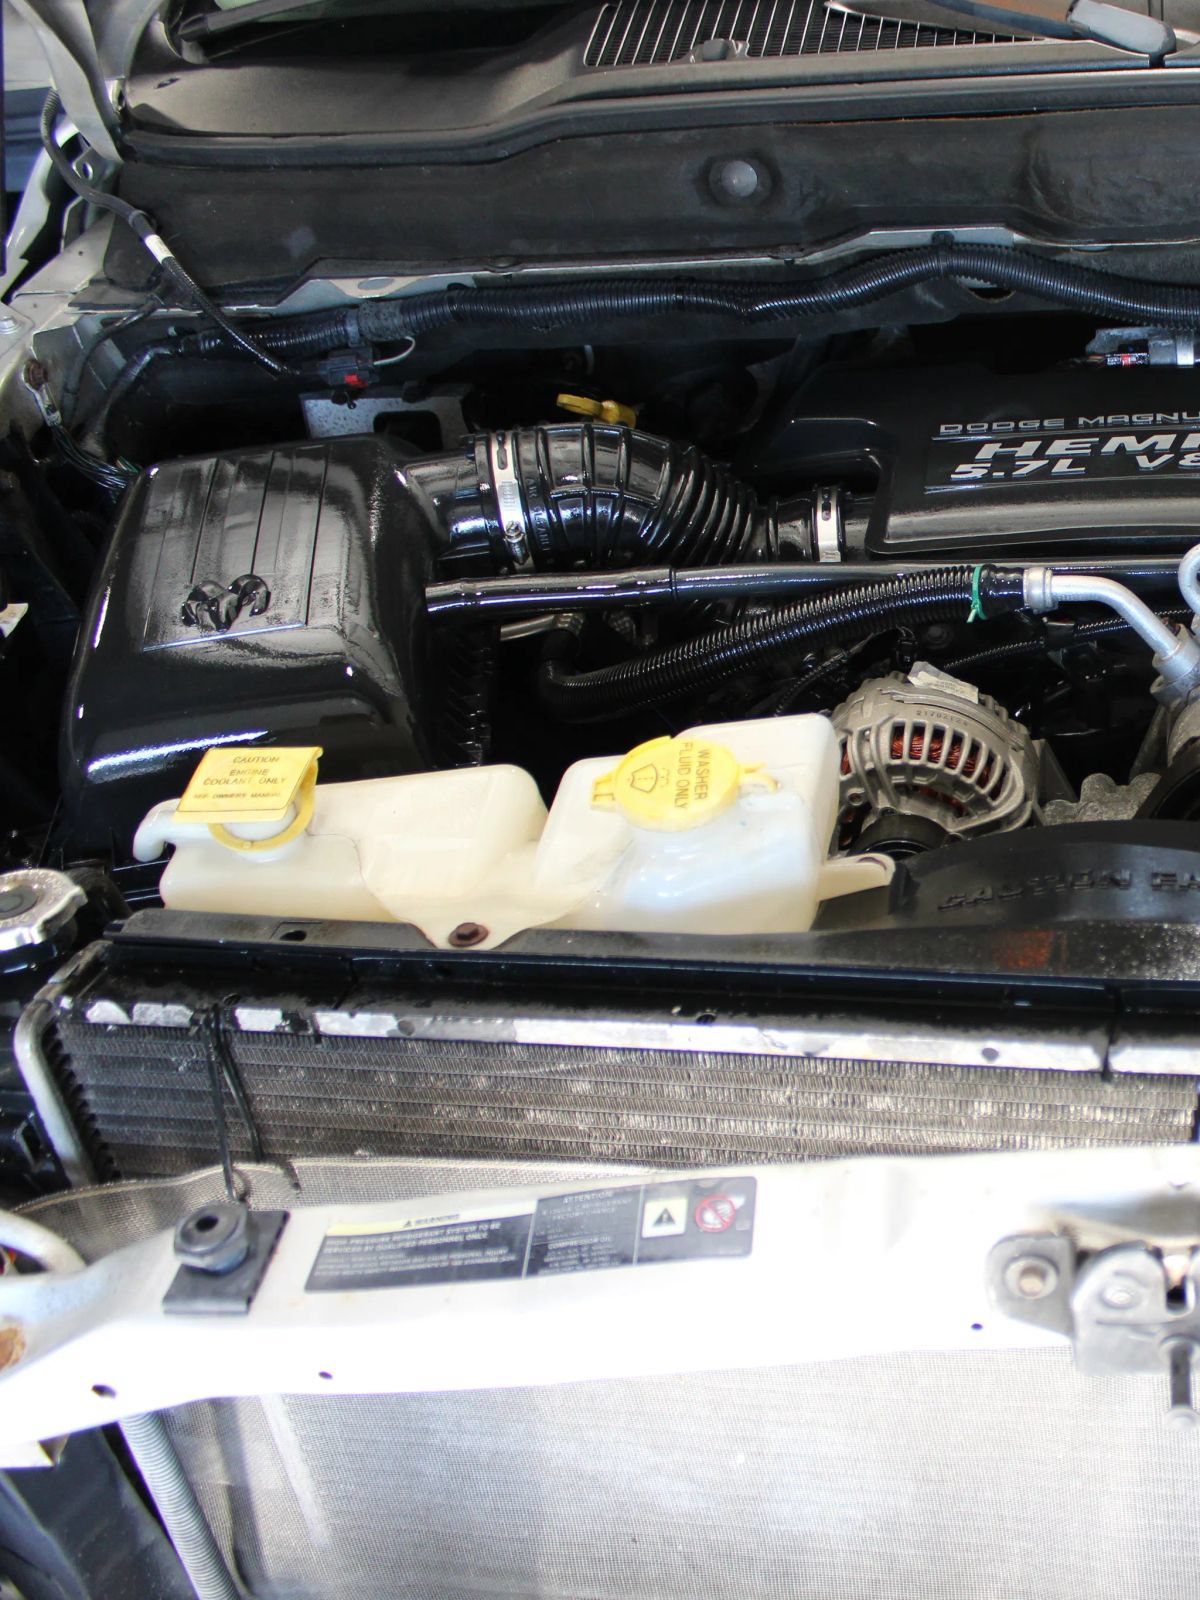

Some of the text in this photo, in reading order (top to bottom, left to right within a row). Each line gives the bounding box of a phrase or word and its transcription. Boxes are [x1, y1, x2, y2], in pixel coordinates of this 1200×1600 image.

[940, 418, 1065, 435] DODGE
[950, 458, 1086, 480] 5.7L
[232, 756, 280, 764] CAUTION
[229, 768, 270, 777] ENGINE
[674, 741, 694, 809] FLUID ONLY
[693, 748, 713, 801] WASHER
[203, 777, 288, 786] COOLANT ONLY
